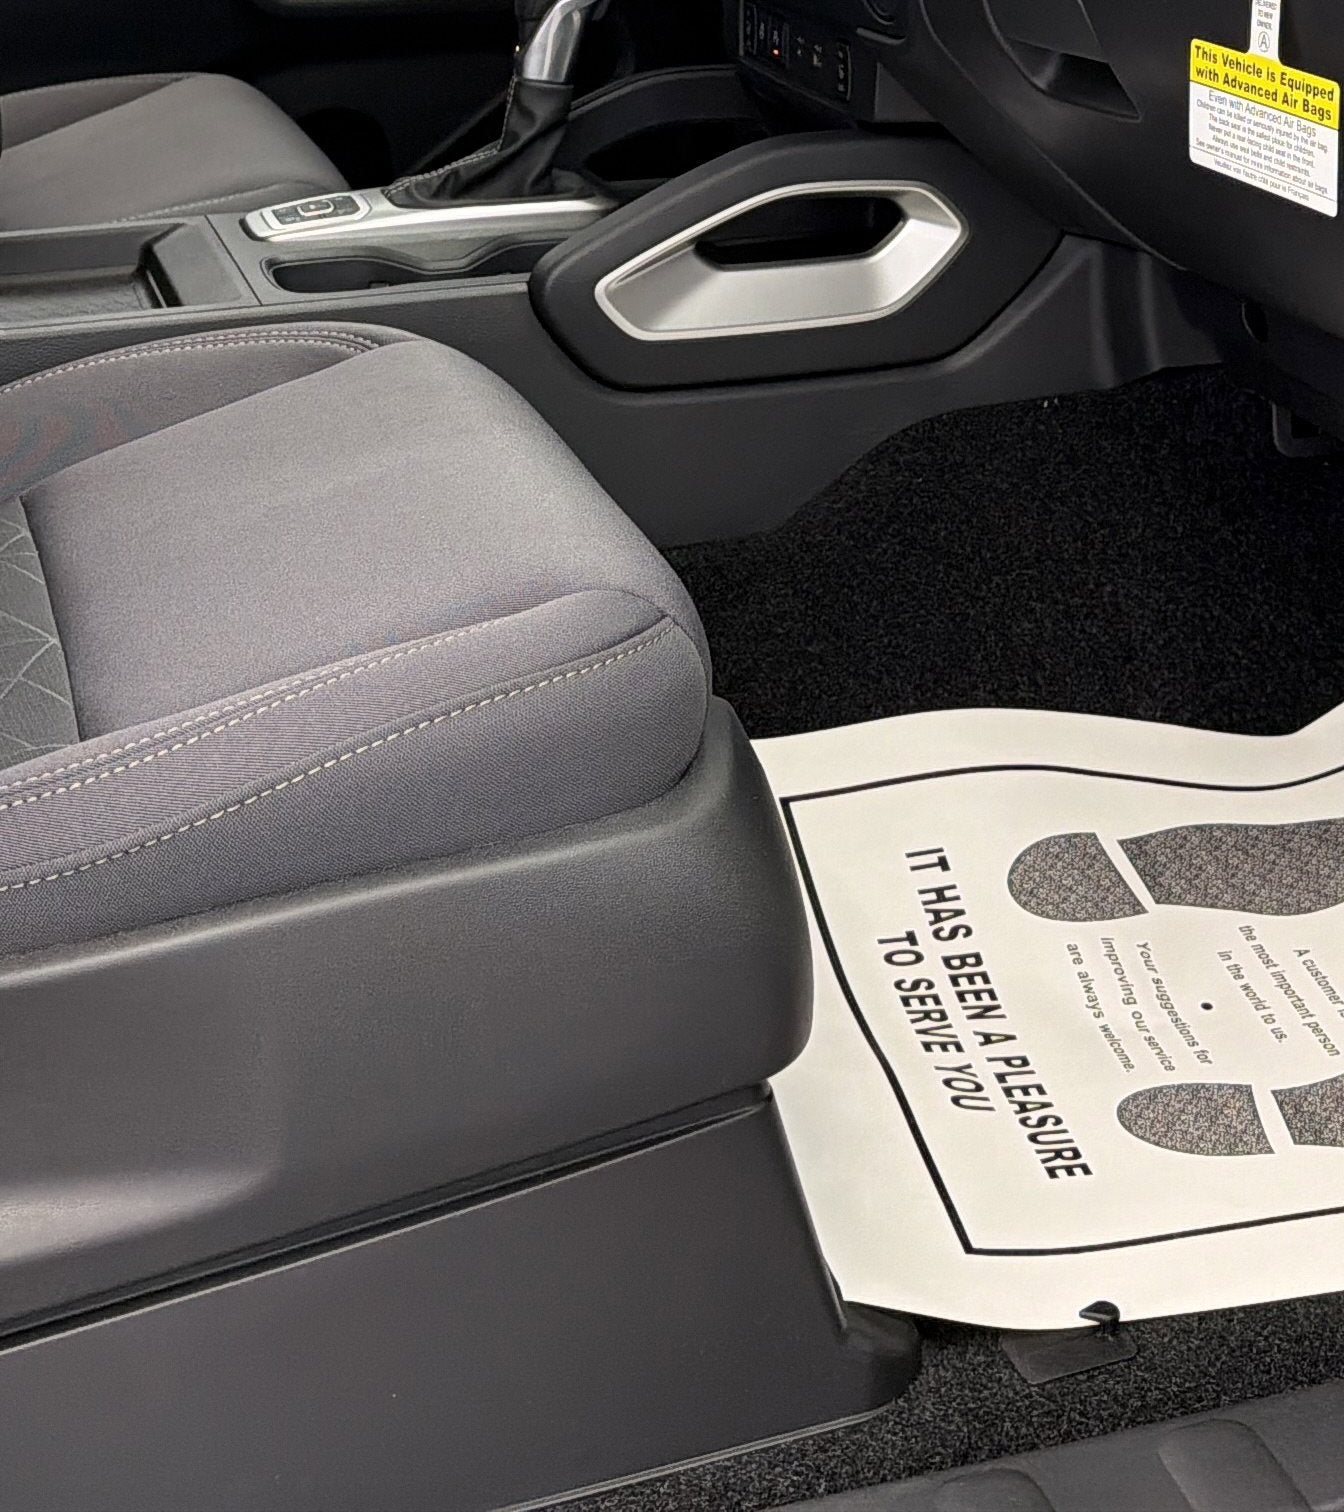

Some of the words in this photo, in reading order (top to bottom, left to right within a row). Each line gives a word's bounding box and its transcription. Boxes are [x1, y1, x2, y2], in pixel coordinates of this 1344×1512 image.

[1195, 45, 1218, 64] This
[1222, 53, 1263, 79] Vehicle
[1266, 67, 1276, 82] is
[1280, 72, 1335, 102] Equipped
[1196, 66, 1219, 83] with
[1223, 72, 1278, 103] Advanced
[1282, 92, 1298, 109] Air
[1302, 99, 1332, 121] Bags
[1209, 90, 1228, 106] Even
[1229, 98, 1244, 112] with
[1245, 100, 1282, 125] Advanced
[1283, 116, 1294, 129] Air
[1297, 119, 1317, 139] Bags
[905, 847, 951, 873] IT
[917, 884, 973, 942] HAS
[877, 930, 925, 967] TO
[1292, 949, 1311, 957] A
[1302, 958, 1344, 1006] customer
[941, 952, 1008, 1021] BEEN
[1066, 943, 1084, 965] are
[1077, 970, 1105, 1019] always
[1099, 1023, 1135, 1074] welcome.
[1136, 942, 1159, 974] Your
[1152, 977, 1200, 1048] suggestions
[1193, 1049, 1213, 1065] for
[1217, 950, 1233, 962] in
[1226, 963, 1245, 980] the
[1240, 982, 1271, 1012] world
[1261, 1013, 1276, 1025] to
[1270, 1027, 1288, 1043] us.
[1238, 925, 1257, 942] the
[1251, 943, 1279, 969] most
[1270, 969, 1316, 1019] important
[1302, 1021, 1341, 1057] person
[893, 978, 965, 1054] SERVE
[972, 1030, 1018, 1046] A
[1131, 1010, 1151, 1033] our
[1144, 1035, 1176, 1072] service
[934, 1062, 996, 1112] YOU
[985, 1055, 1094, 1180] PLEASURE
